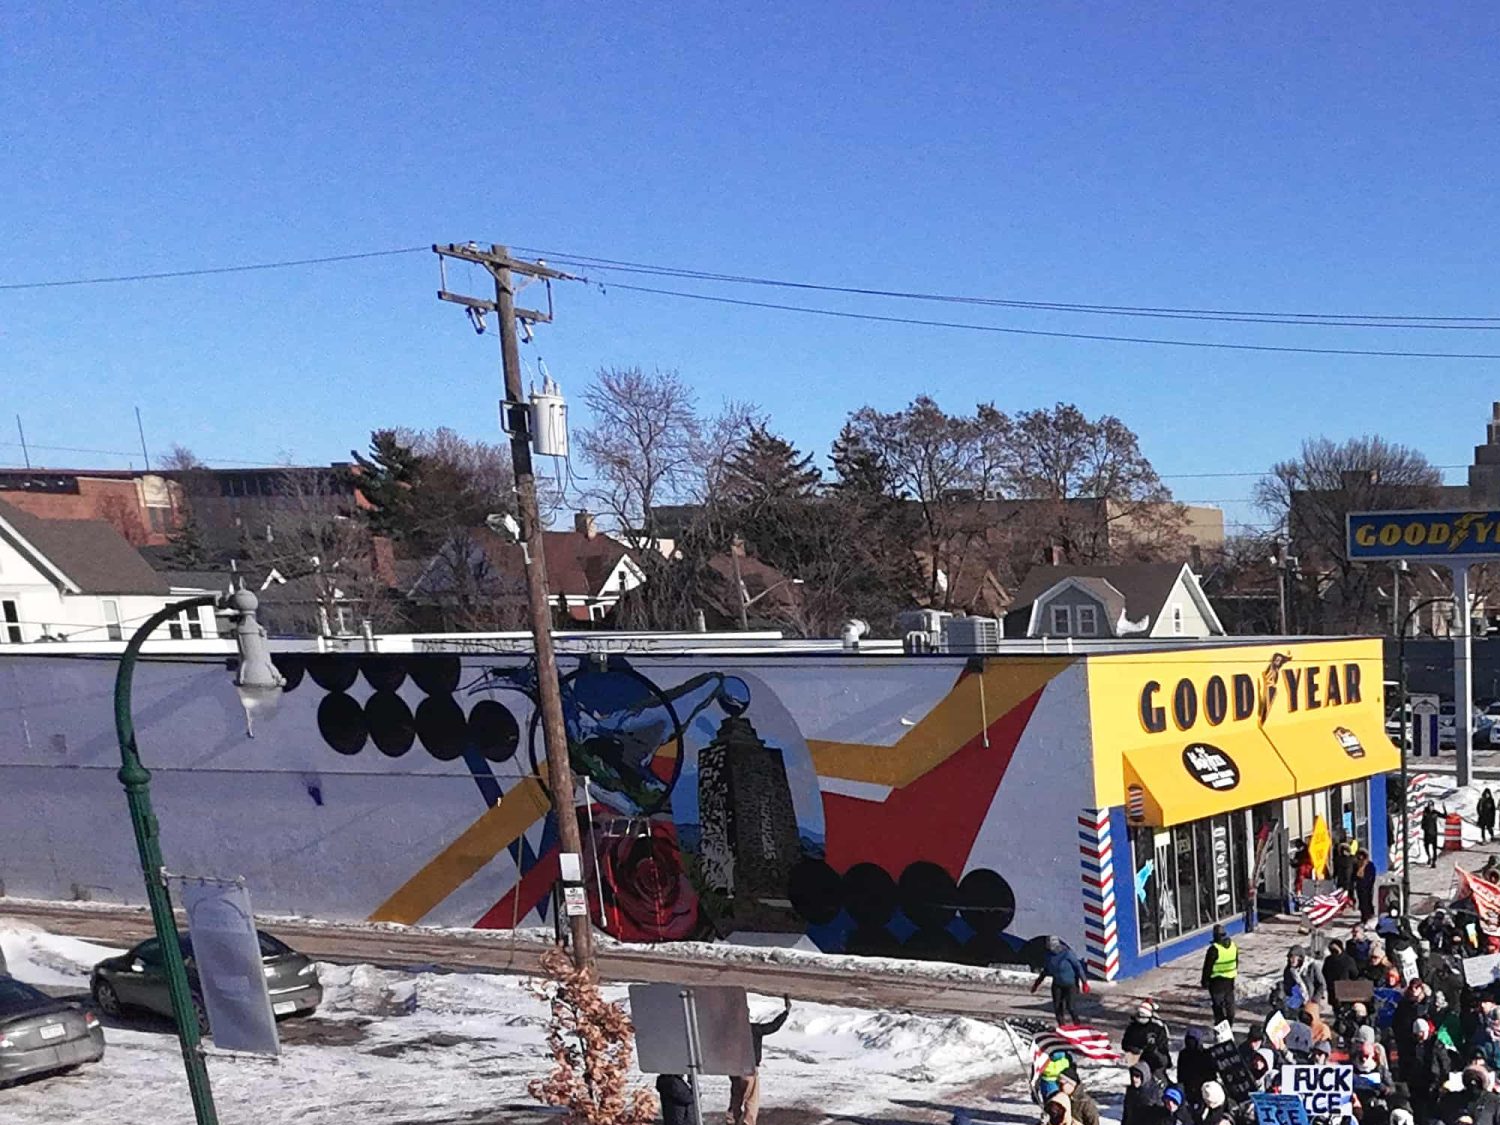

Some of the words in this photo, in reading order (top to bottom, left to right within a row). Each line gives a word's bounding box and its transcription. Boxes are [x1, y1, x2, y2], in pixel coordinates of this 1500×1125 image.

[1138, 662, 1362, 733] GOODYEAR
[1293, 1066, 1351, 1092] FUCK
[1262, 1107, 1300, 1125] ICE
